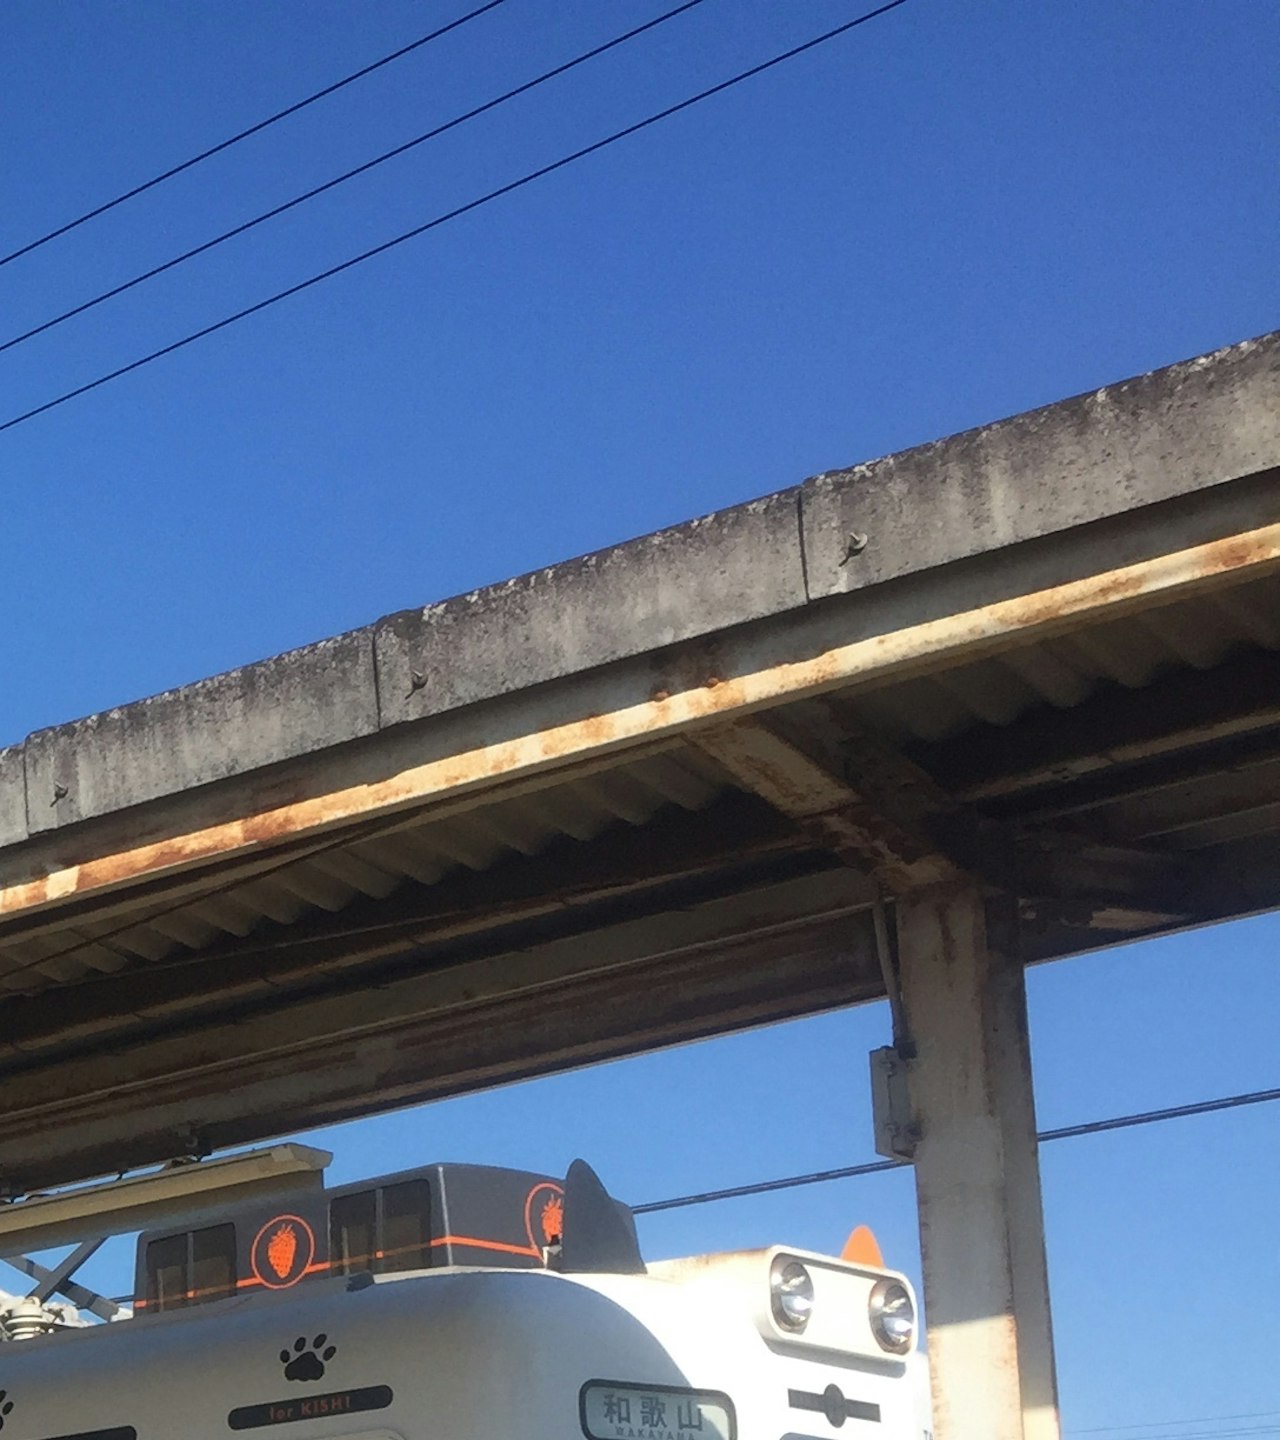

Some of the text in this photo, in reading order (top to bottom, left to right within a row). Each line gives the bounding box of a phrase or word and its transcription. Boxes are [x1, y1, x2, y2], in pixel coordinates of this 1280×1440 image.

[301, 1396, 350, 1416] KISHI
[603, 1394, 703, 1431] 和歌山
